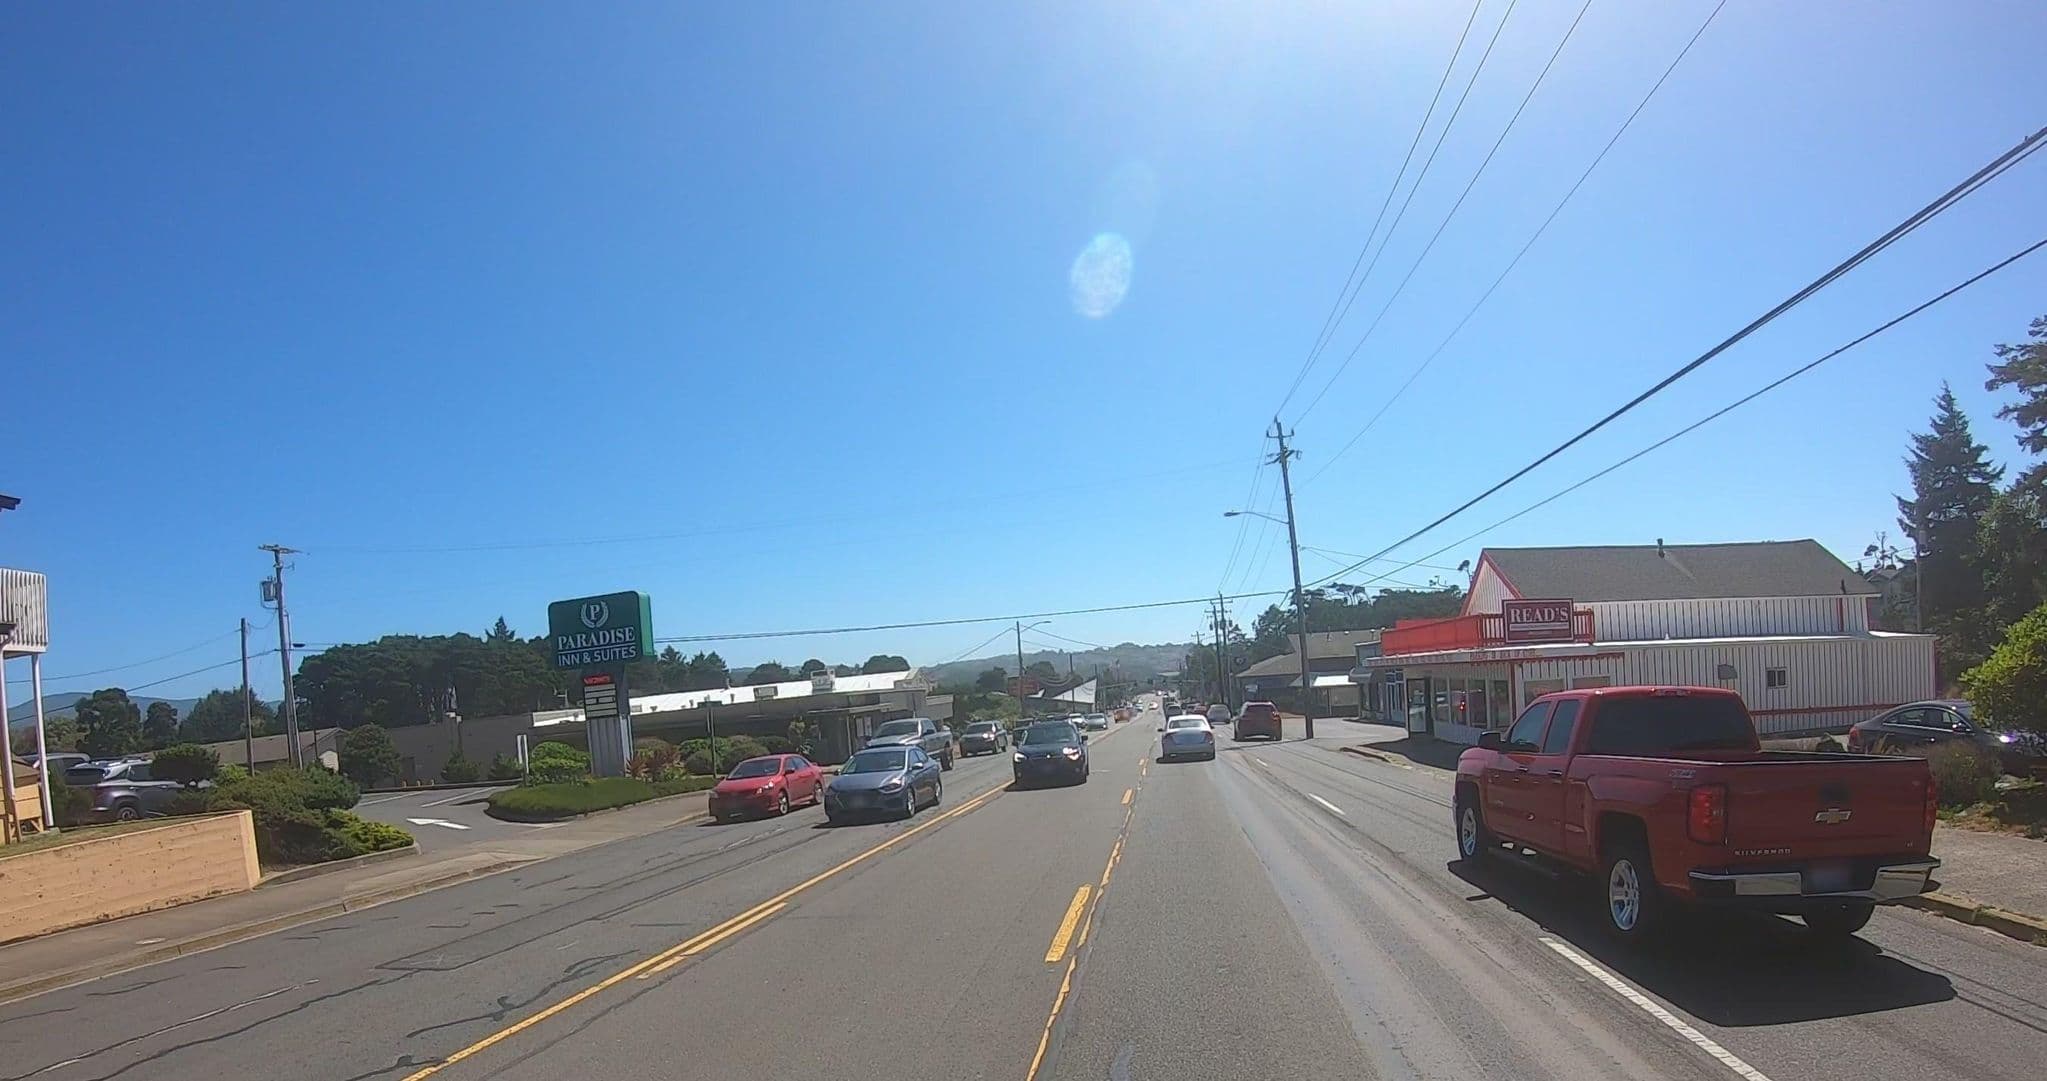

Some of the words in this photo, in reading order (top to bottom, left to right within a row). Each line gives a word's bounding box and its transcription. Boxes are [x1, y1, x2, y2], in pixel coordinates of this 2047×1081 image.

[590, 604, 600, 620] P
[1510, 607, 1569, 623] READ'S
[558, 627, 635, 650] PARADISE
[558, 653, 580, 667] INN
[583, 652, 591, 664] &
[594, 646, 636, 662] SUITES
